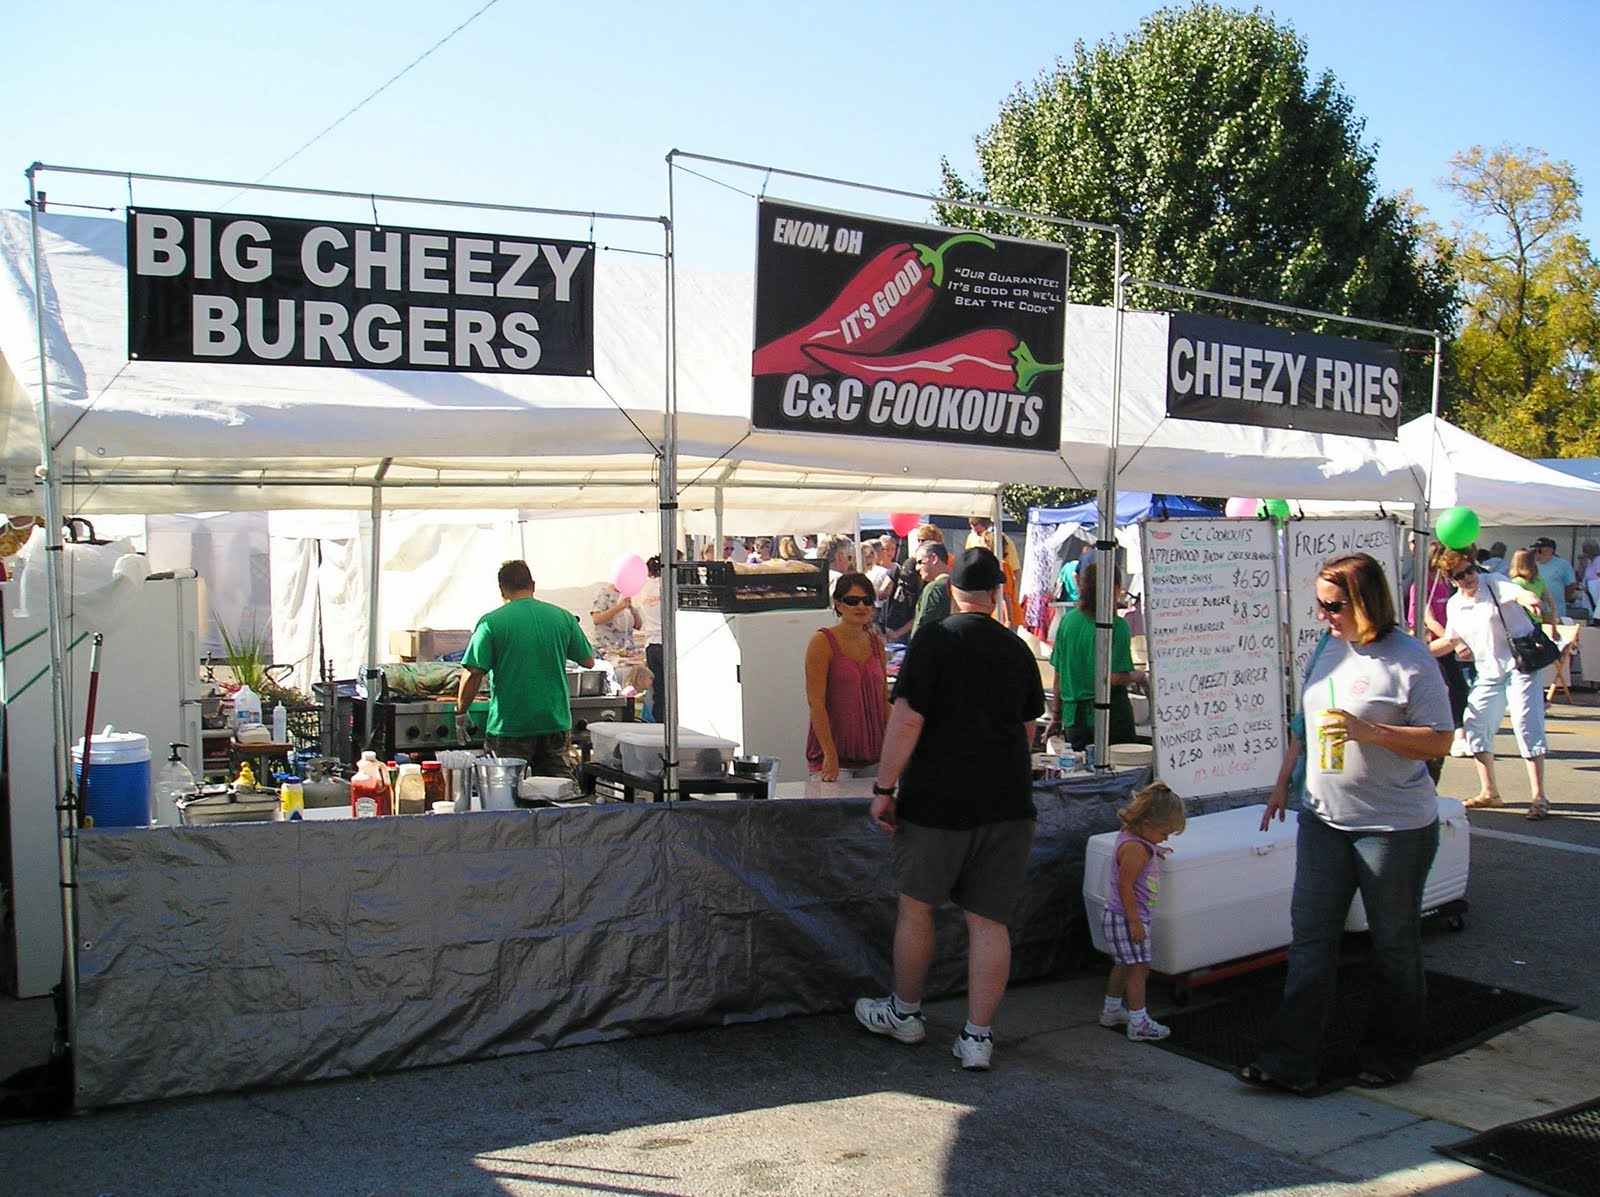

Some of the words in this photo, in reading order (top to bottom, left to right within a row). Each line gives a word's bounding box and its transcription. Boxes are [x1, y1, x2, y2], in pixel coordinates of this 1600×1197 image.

[773, 218, 829, 252] ENON,
[834, 228, 863, 255] OH
[136, 213, 273, 283] BIG
[301, 226, 588, 302] CHEEZY
[948, 280, 969, 292] IT'S
[973, 284, 1009, 296] GOOD
[1012, 288, 1029, 298] OR
[1032, 290, 1062, 302] WE'LL
[988, 271, 1060, 288] GUARANTEE:
[839, 303, 877, 345] IT'S
[872, 259, 924, 317] GOOD
[954, 296, 987, 308] BEAT
[991, 299, 1015, 310] THE
[1018, 301, 1055, 315] COOK"
[192, 294, 542, 369] BURGERS
[1170, 337, 1307, 406] CHEEZY
[1315, 357, 1400, 418] FRIES
[782, 373, 865, 422] C&C
[868, 380, 1044, 437] COOKOUTS
[1295, 531, 1337, 557] FRIES
[1233, 567, 1270, 589] $6.50
[1170, 748, 1203, 769] $2.50
[877, 1012, 886, 1024] N
